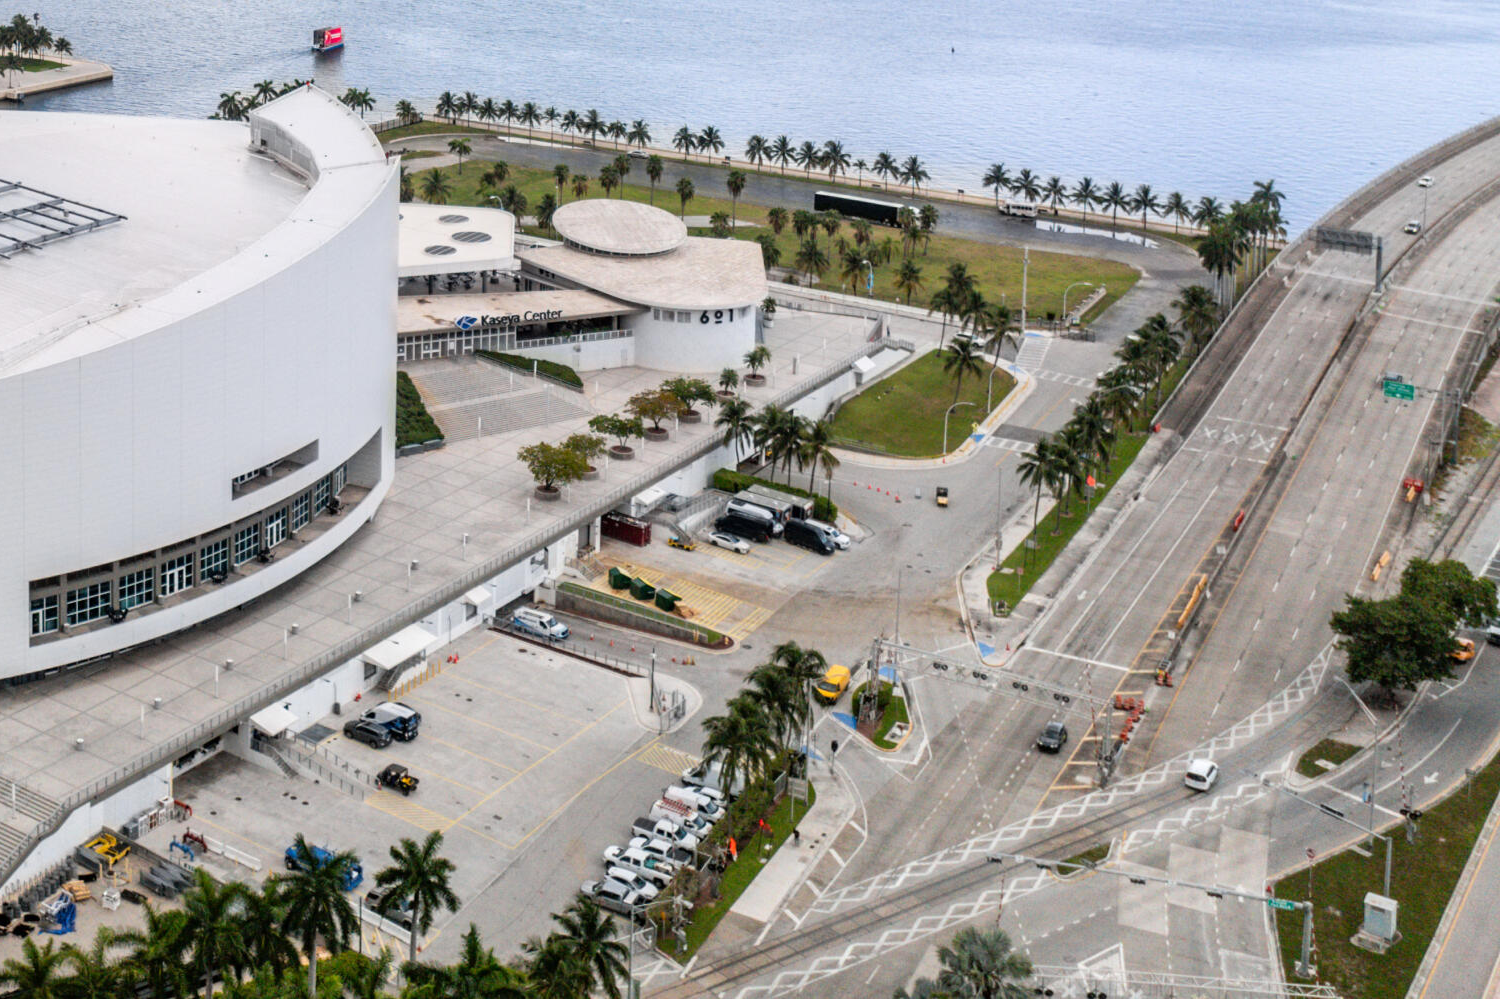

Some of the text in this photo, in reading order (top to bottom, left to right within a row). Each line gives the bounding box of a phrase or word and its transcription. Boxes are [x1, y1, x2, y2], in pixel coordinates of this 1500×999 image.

[481, 309, 562, 326] Kaseya Center
[700, 308, 733, 324] 601
